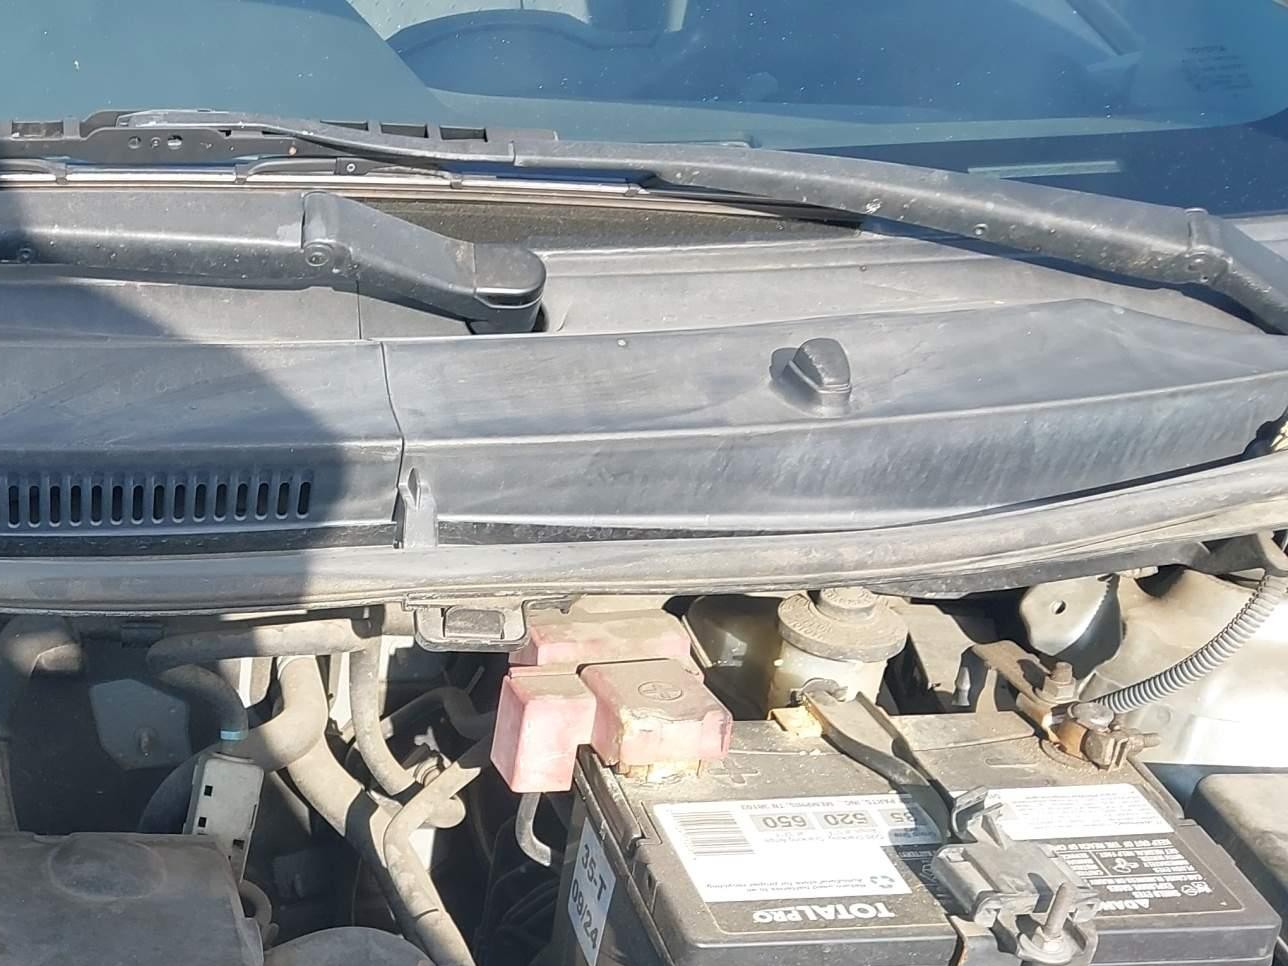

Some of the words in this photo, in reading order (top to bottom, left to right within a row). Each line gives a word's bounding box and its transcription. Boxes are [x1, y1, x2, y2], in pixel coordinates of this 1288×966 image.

[762, 815, 807, 828] 650
[823, 813, 868, 825] 520
[752, 902, 897, 924] TOTALPRO
